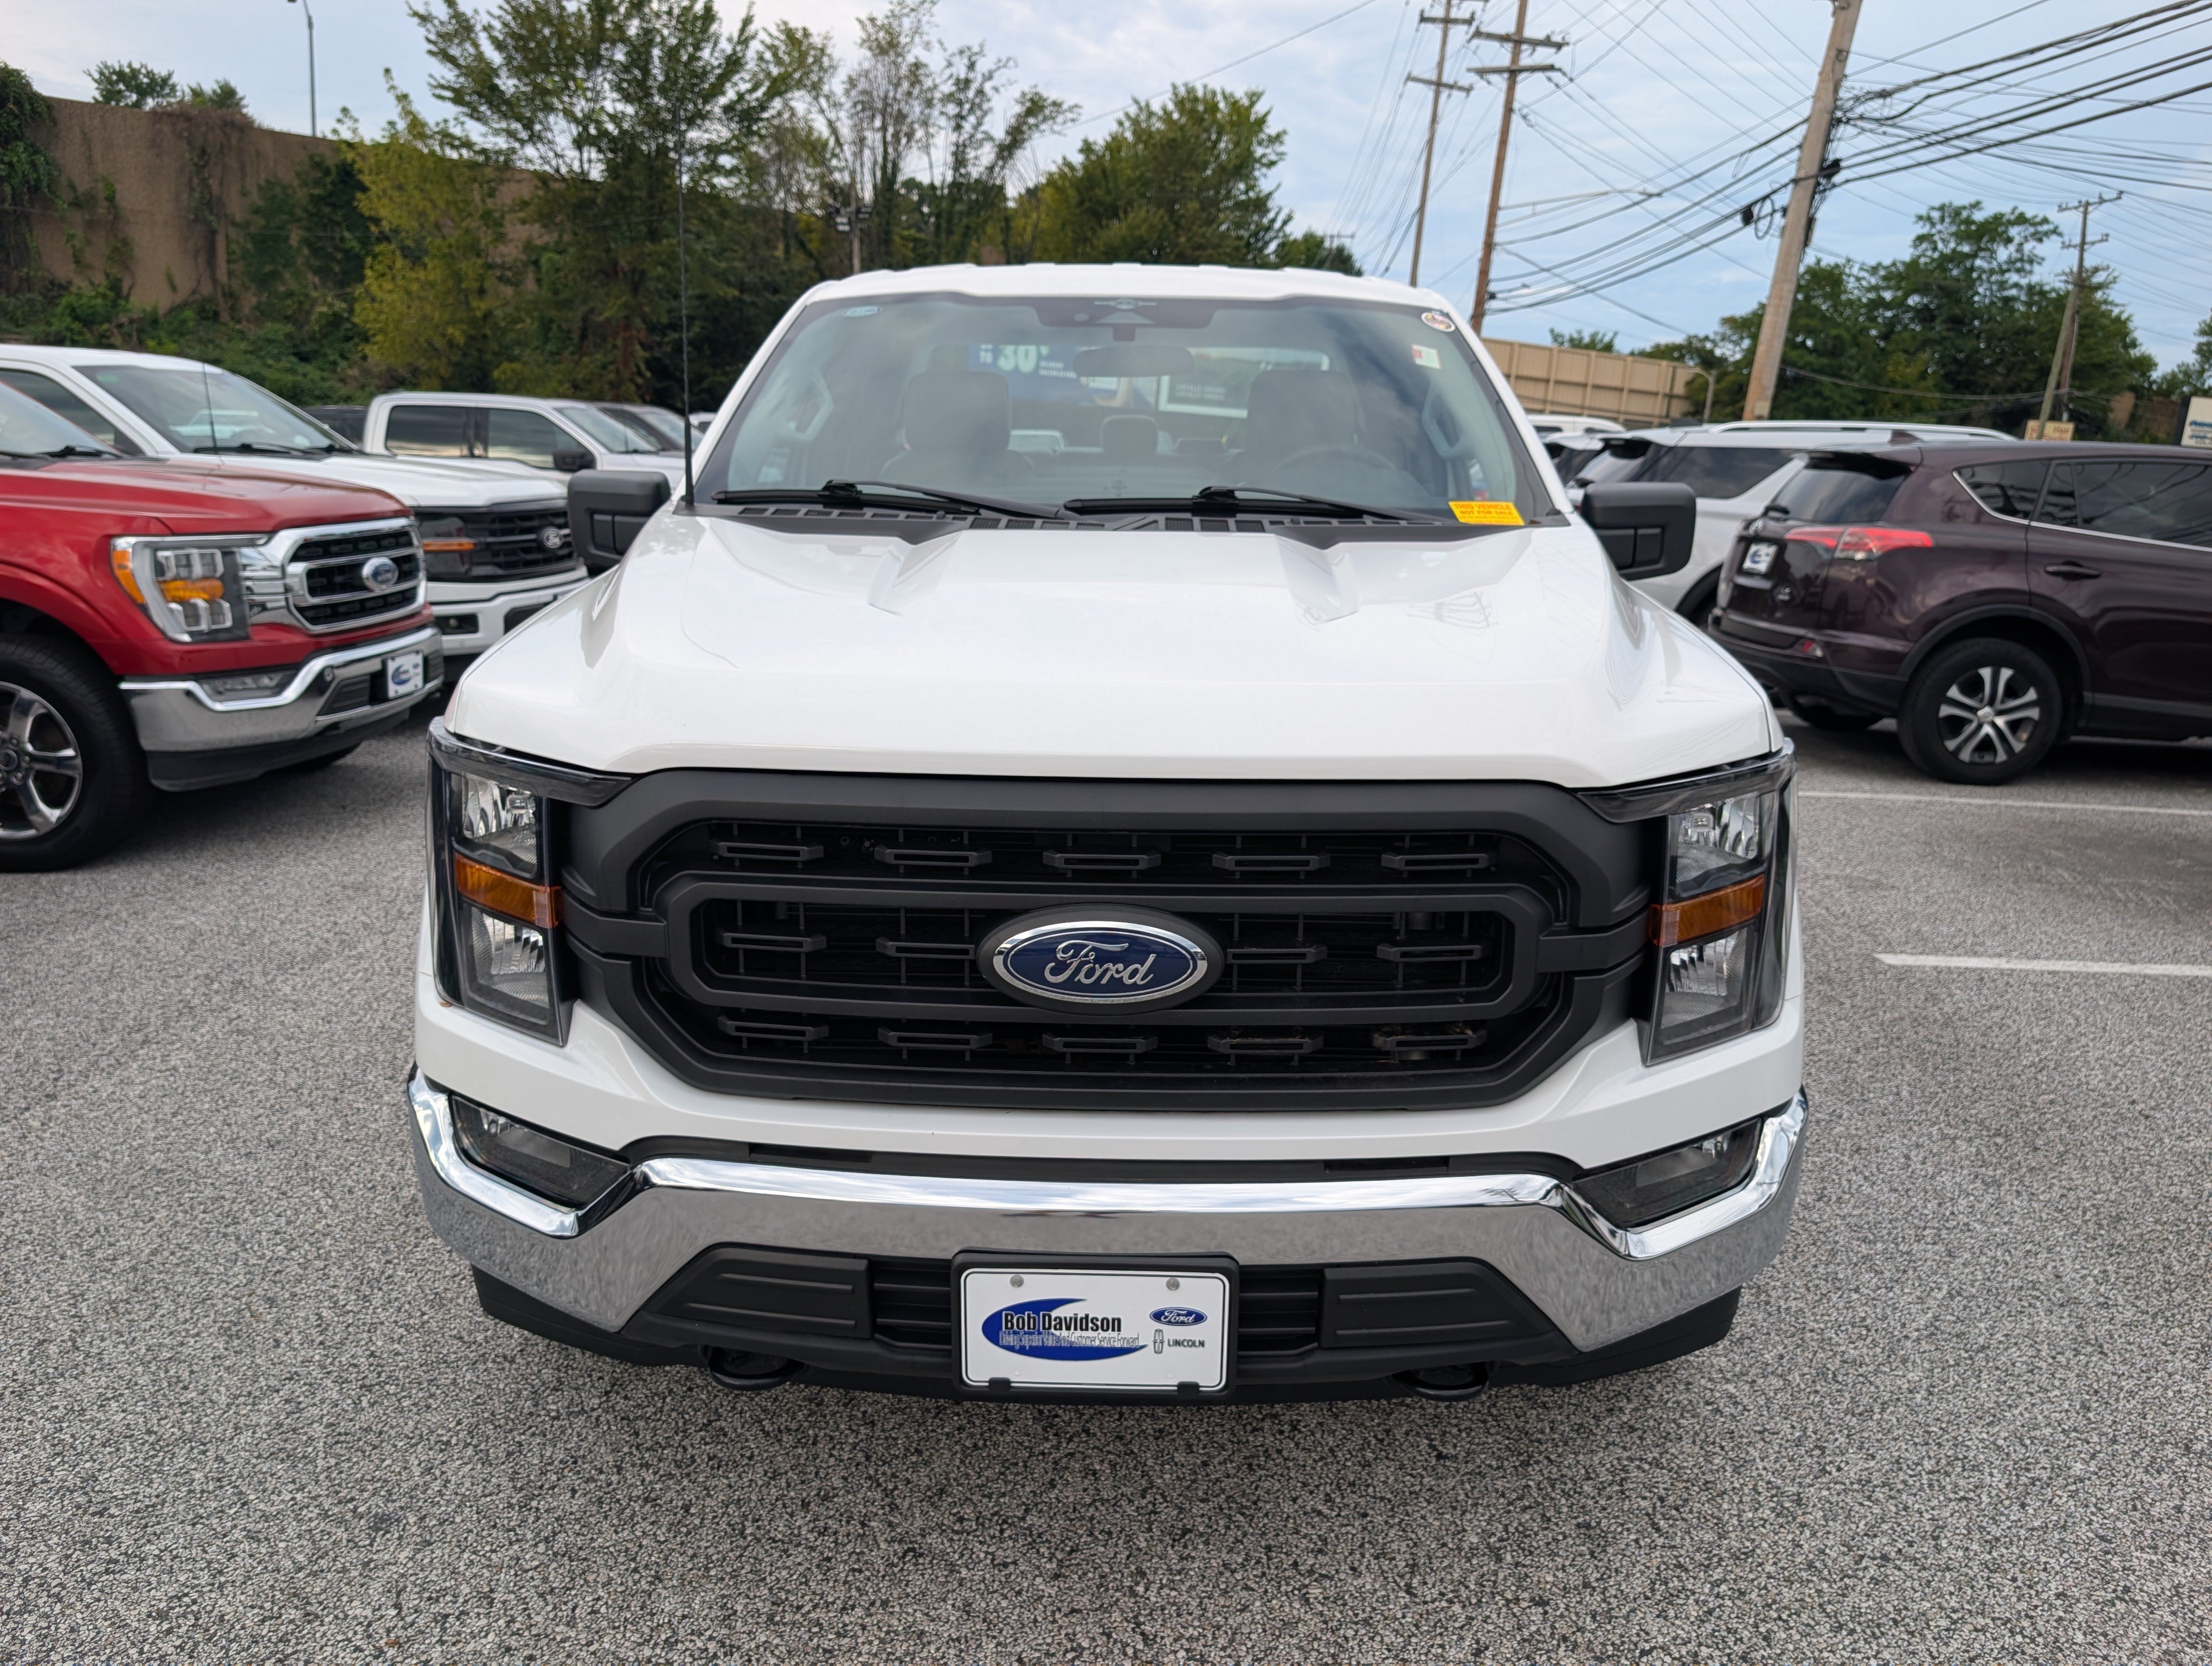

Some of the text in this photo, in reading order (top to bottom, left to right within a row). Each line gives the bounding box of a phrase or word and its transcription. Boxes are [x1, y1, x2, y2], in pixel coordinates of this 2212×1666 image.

[1044, 940, 1157, 985] Ford
[1004, 1312, 1122, 1332] Bob Davidson
[1160, 1309, 1196, 1323] Ford
[1070, 1332, 1096, 1346] Customer
[1097, 1332, 1117, 1347] Service
[1167, 1338, 1205, 1348] LINCOLN
